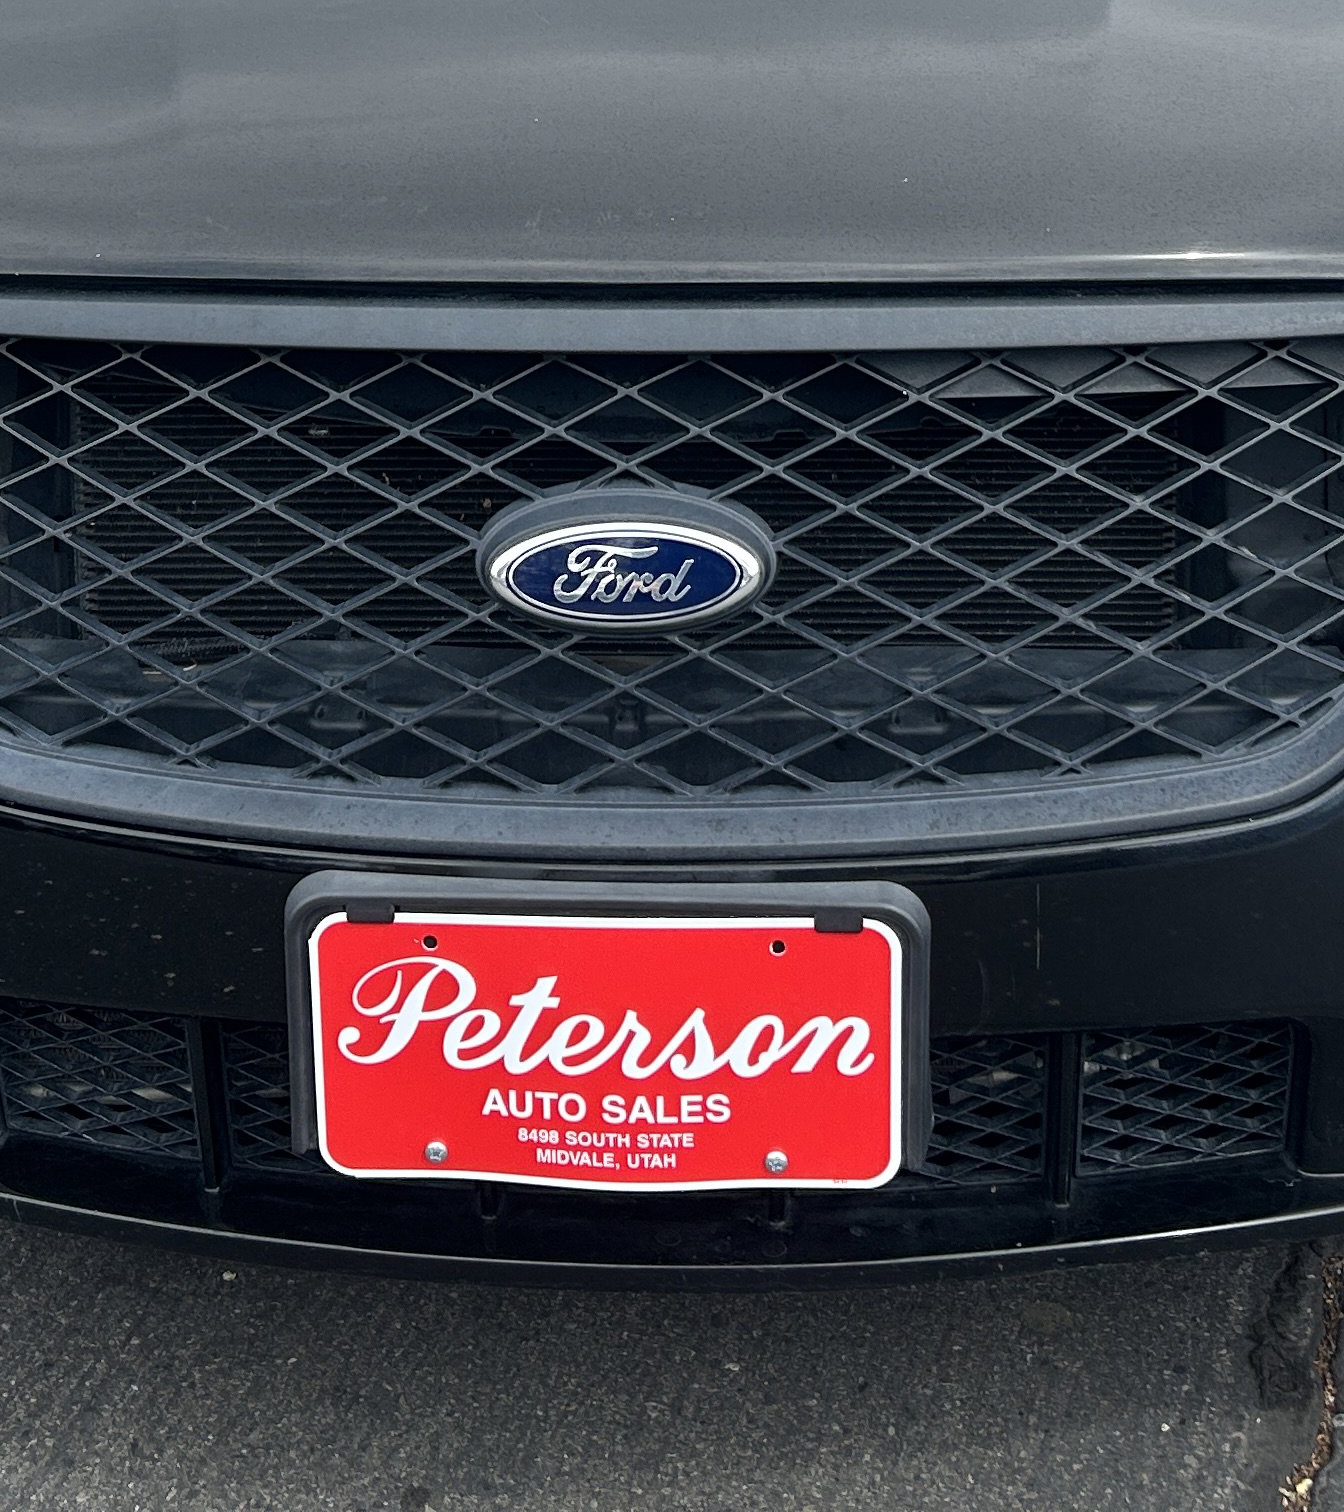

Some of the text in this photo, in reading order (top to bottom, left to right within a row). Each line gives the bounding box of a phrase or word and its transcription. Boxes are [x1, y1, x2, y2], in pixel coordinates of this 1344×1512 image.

[553, 544, 694, 604] Ford
[337, 955, 875, 1080] Peterson
[482, 1088, 731, 1125] AUTO SALES
[517, 1127, 695, 1149] 8498 SOUTH STATE
[536, 1148, 677, 1169] MIDVALE, UTAH
